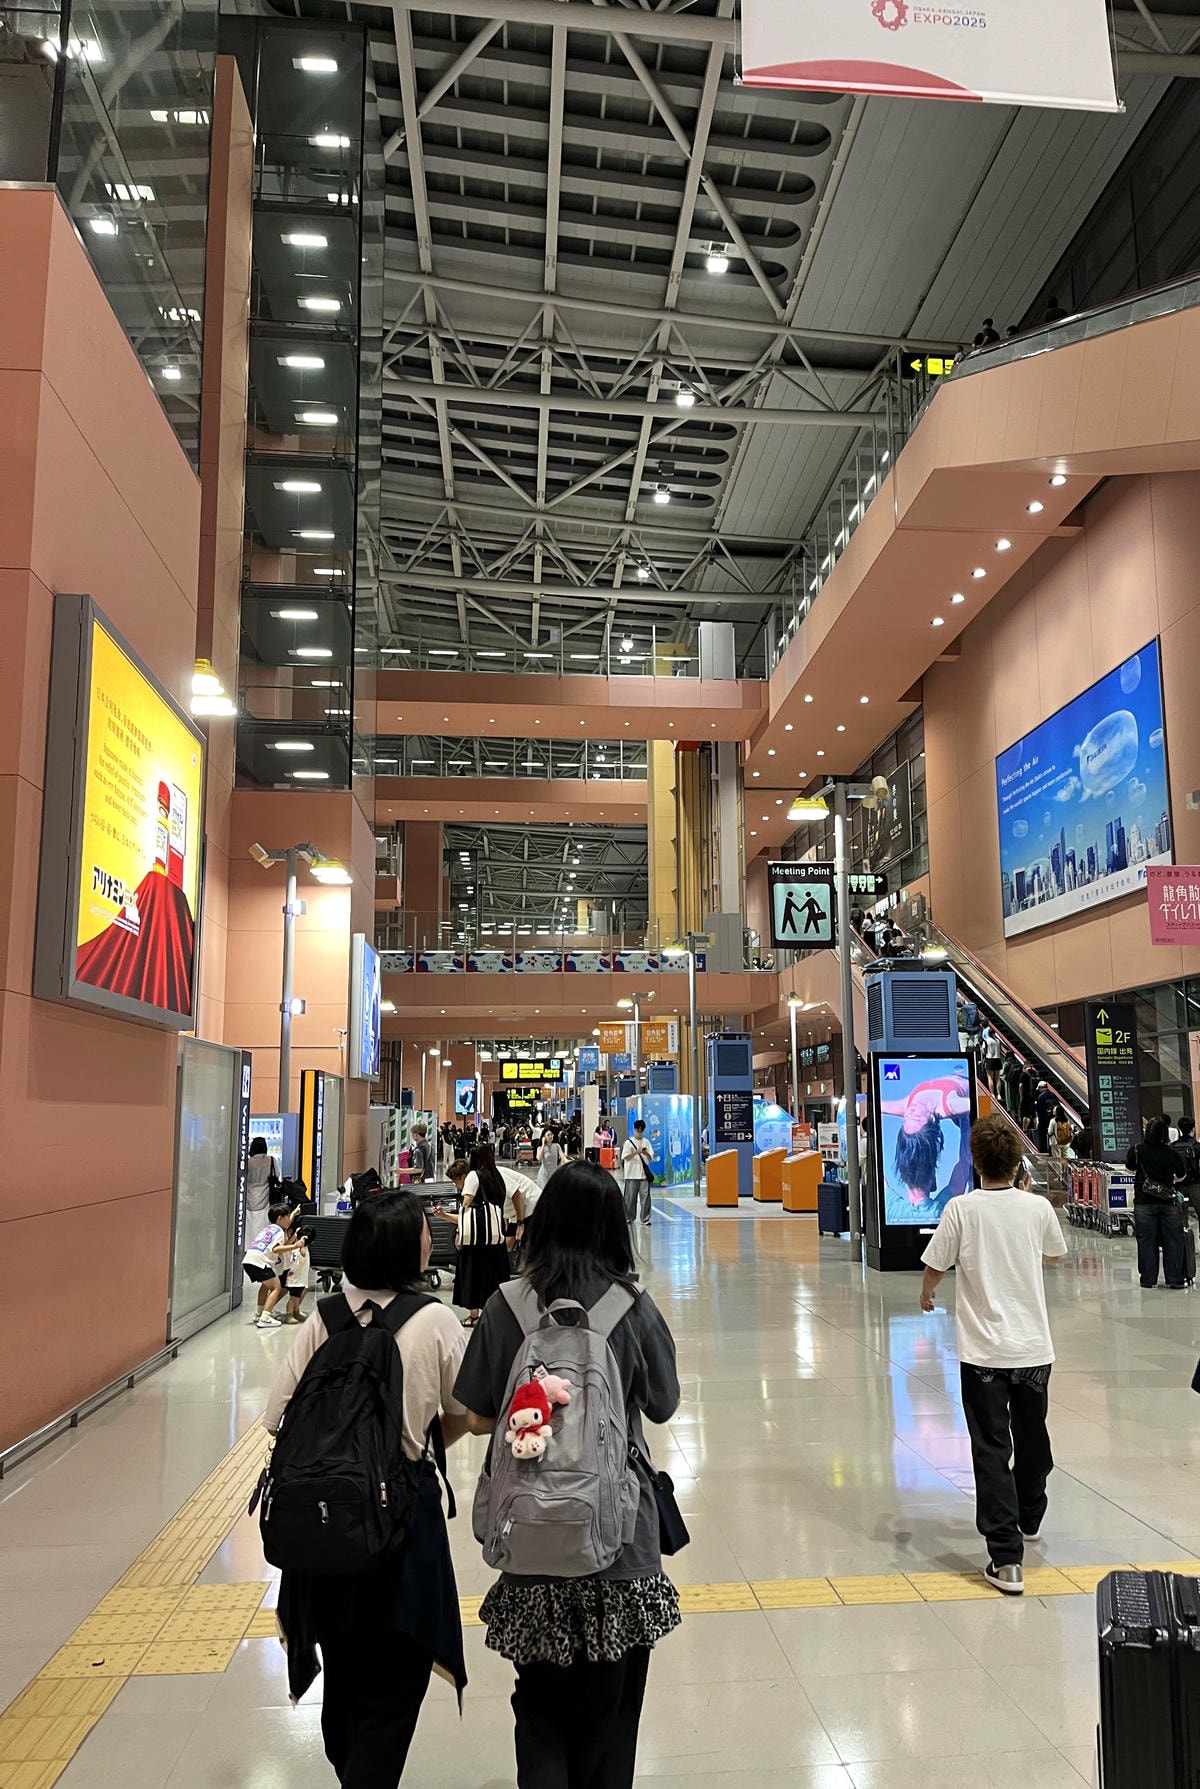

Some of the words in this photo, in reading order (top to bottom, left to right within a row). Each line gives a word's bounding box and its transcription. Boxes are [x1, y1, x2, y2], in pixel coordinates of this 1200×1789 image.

[913, 12, 987, 29] EXPO2025
[1001, 768, 1022, 787] Perfecting
[1023, 762, 1031, 772] the
[1032, 756, 1040, 767] Air
[772, 866, 806, 877] Meeting
[808, 866, 830, 876] Point
[1115, 1030, 1131, 1043] 2F
[1100, 1078, 1111, 1086] T2
[240, 1104, 248, 1170] Vending
[237, 1176, 246, 1246] Machine
